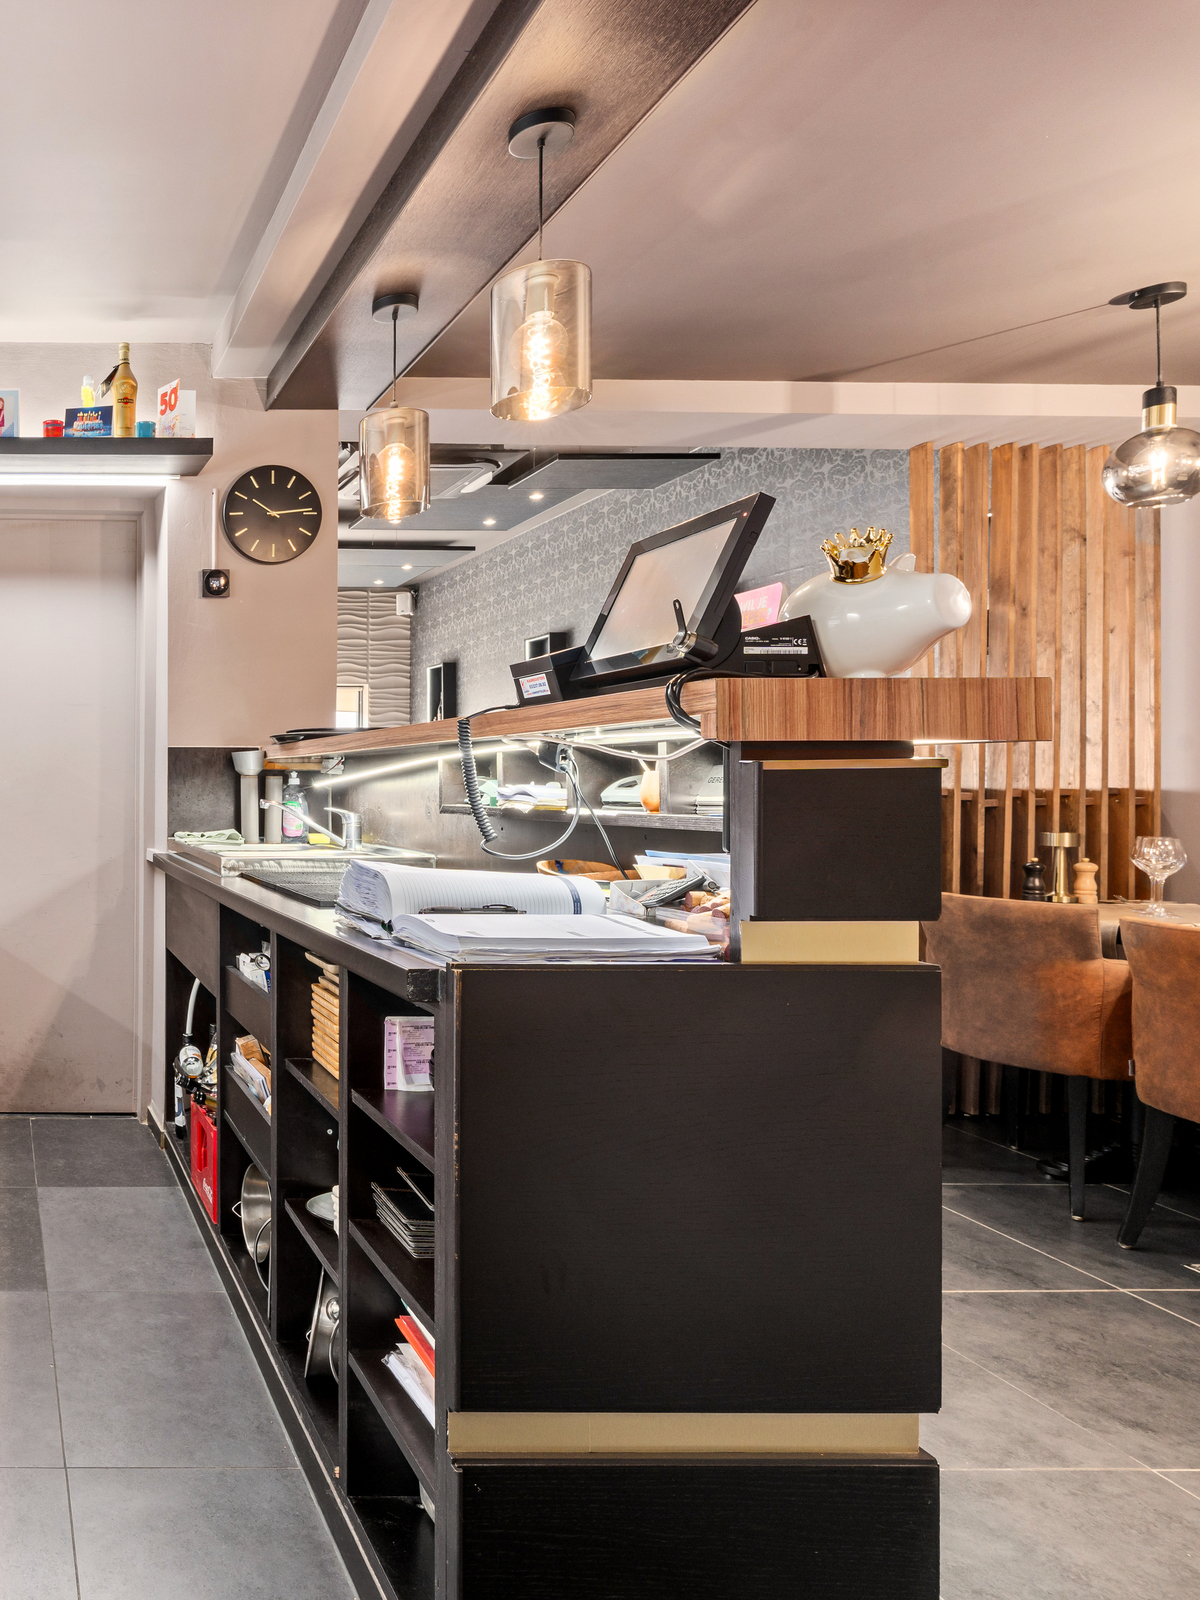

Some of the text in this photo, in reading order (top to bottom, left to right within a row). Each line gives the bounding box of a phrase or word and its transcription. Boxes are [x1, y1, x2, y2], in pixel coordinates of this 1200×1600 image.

[159, 387, 178, 416] 50
[741, 596, 768, 612] WIL JE
